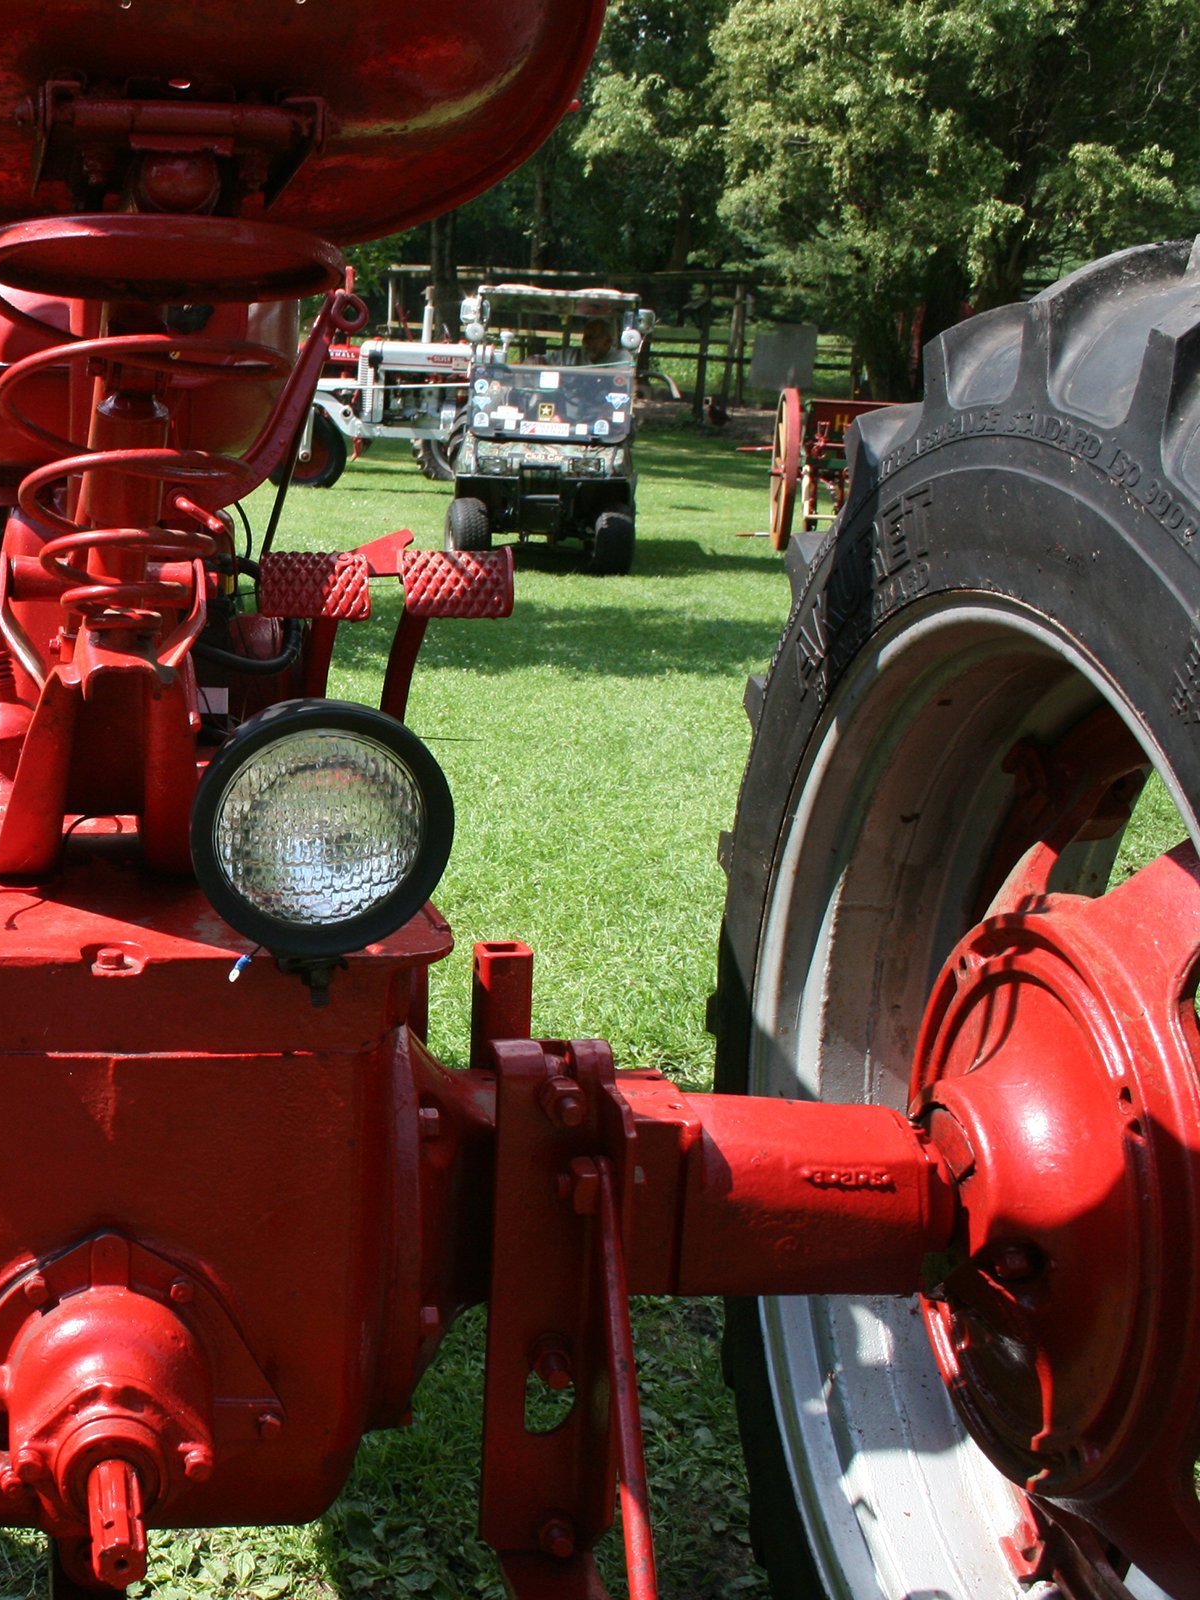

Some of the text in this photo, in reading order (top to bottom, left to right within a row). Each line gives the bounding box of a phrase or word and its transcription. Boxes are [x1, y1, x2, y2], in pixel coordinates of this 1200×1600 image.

[1002, 411, 1102, 459] STANDARD
[524, 452, 564, 461] Club Car
